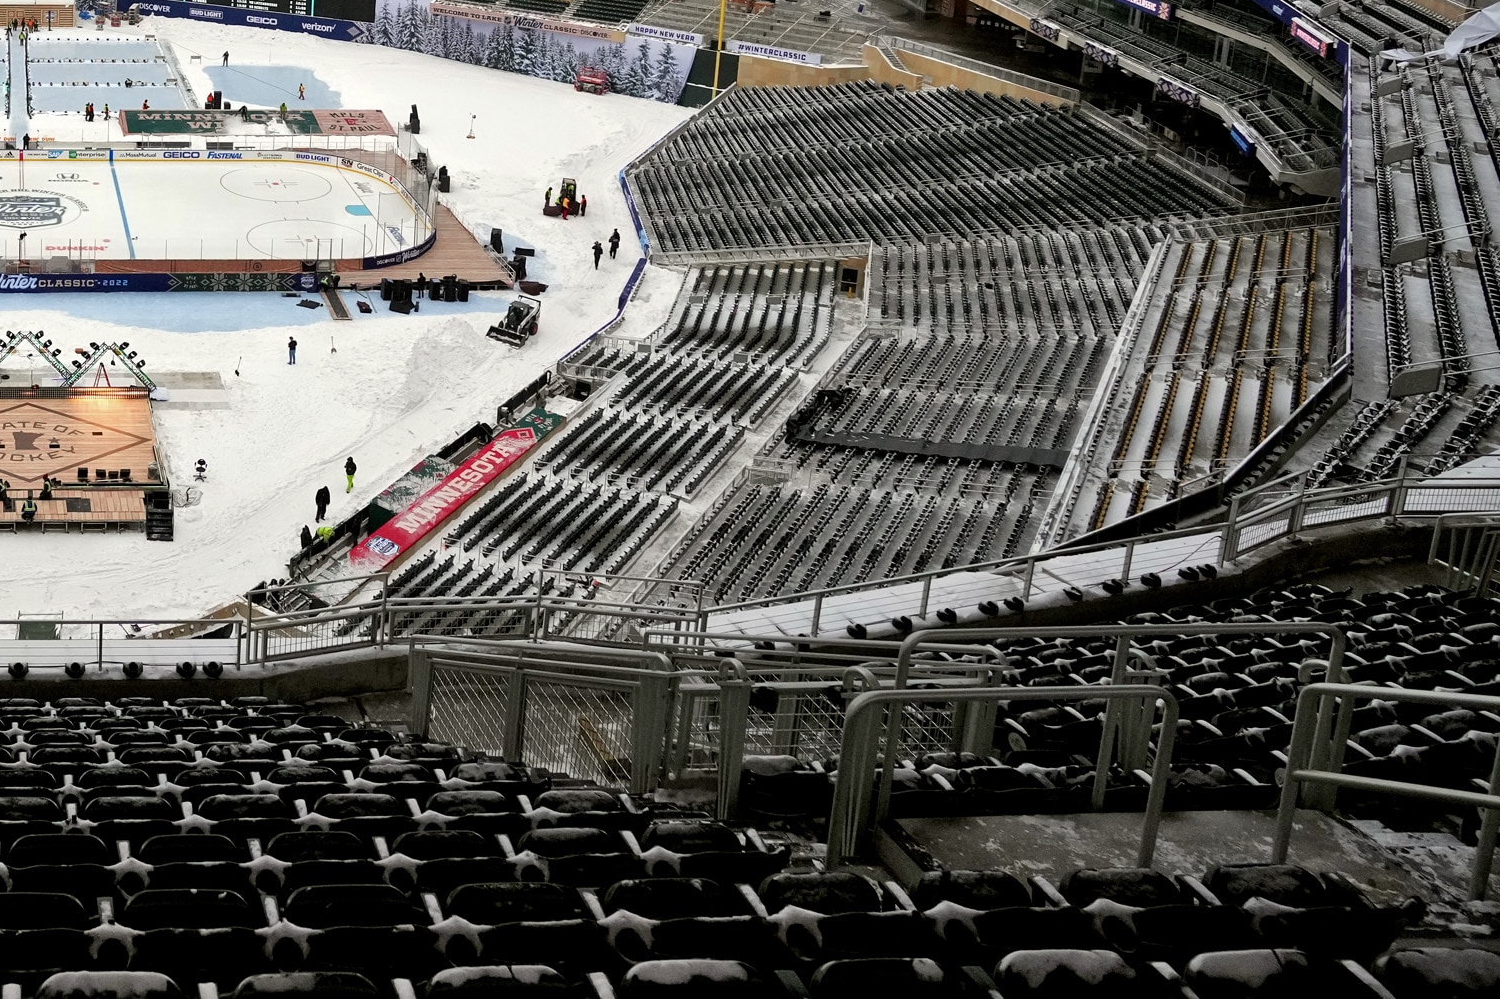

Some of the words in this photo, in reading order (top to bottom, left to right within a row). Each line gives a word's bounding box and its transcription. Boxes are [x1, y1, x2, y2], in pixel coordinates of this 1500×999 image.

[140, 3, 172, 13] DISCOVER
[191, 9, 204, 17] BUD
[204, 11, 222, 19] LIGHT
[246, 15, 278, 26] GEICO
[433, 7, 470, 17] WELCOME
[482, 15, 502, 23] LAKE
[513, 15, 544, 29] Winter
[544, 24, 578, 34] CLASSIC
[580, 29, 608, 39] DISCOVER
[302, 23, 332, 33] verizon
[635, 26, 658, 36] HAPPY
[660, 29, 674, 38] NEW
[676, 33, 695, 41] YEAR
[738, 44, 806, 61] #WINTERCLASSIC
[163, 151, 200, 159] GEICO
[296, 153, 310, 161] BUD
[311, 155, 330, 163] LIGHT
[357, 163, 372, 173] Great
[371, 169, 384, 178] Clips
[38, 279, 95, 288] CLASSIC
[53, 423, 85, 437] OF
[396, 442, 516, 534] MINNESOTA
